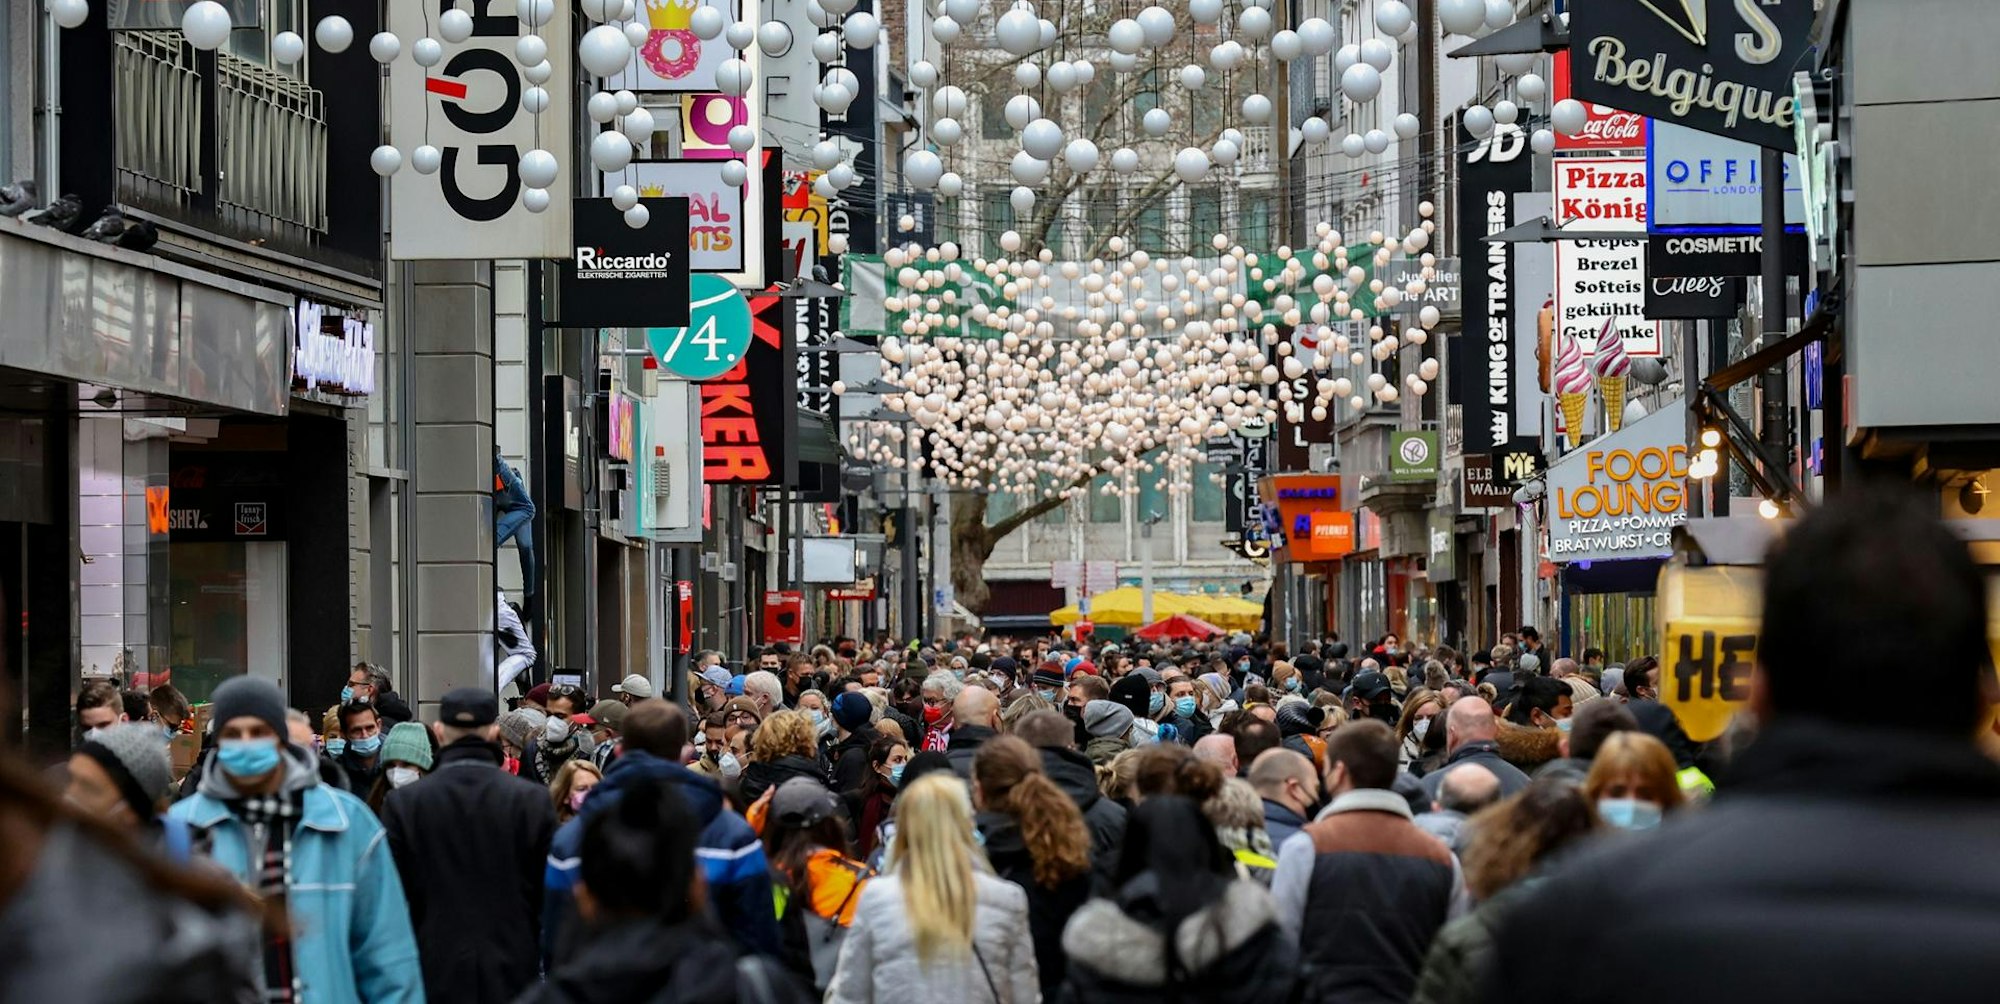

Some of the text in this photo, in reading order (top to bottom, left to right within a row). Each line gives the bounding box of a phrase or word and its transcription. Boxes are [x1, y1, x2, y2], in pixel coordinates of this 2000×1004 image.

[1588, 36, 1794, 128] Belgique
[1584, 114, 1641, 139] ca-Cola
[1566, 167, 1646, 189] Pizza
[1714, 186, 1762, 194] LONDO
[1561, 197, 1647, 223] König
[1577, 256, 1638, 271] Brezel
[624, 271, 668, 279] ZIGARETTEN
[1424, 287, 1460, 302] ART
[1574, 279, 1642, 294] Softeis
[1563, 325, 1654, 340] Getnke
[1488, 343, 1508, 404] KING
[1586, 445, 1687, 484] FOOD
[1467, 467, 1493, 481] ELB
[1557, 480, 1688, 519] LOUNG
[1568, 519, 1612, 534] PIZZA
[1555, 533, 1645, 553] BRATWURST
